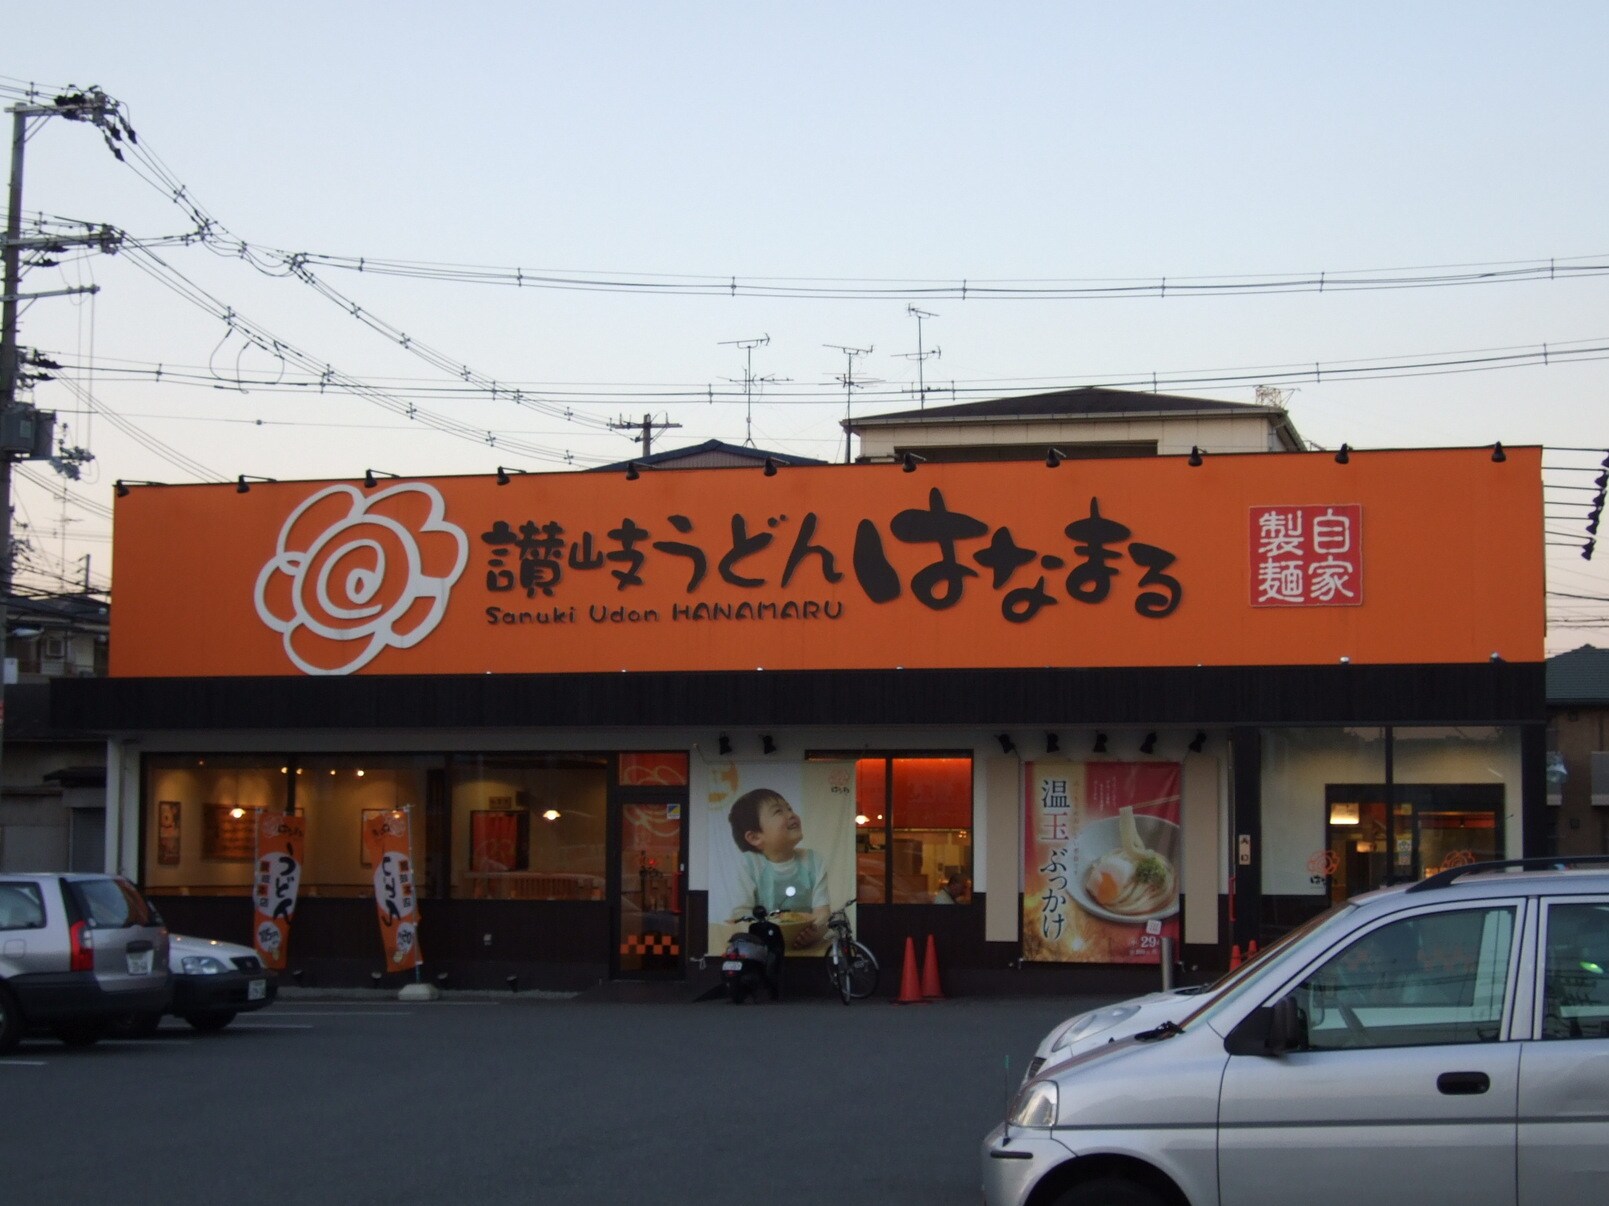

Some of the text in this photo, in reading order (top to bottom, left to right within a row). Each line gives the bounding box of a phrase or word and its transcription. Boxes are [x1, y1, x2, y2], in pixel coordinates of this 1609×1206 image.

[853, 487, 1182, 623] はなまる
[486, 601, 842, 624] Sanuki Udon HANAMARU
[273, 841, 296, 926] うどん
[1040, 780, 1070, 940] 温玉ぶっかけ
